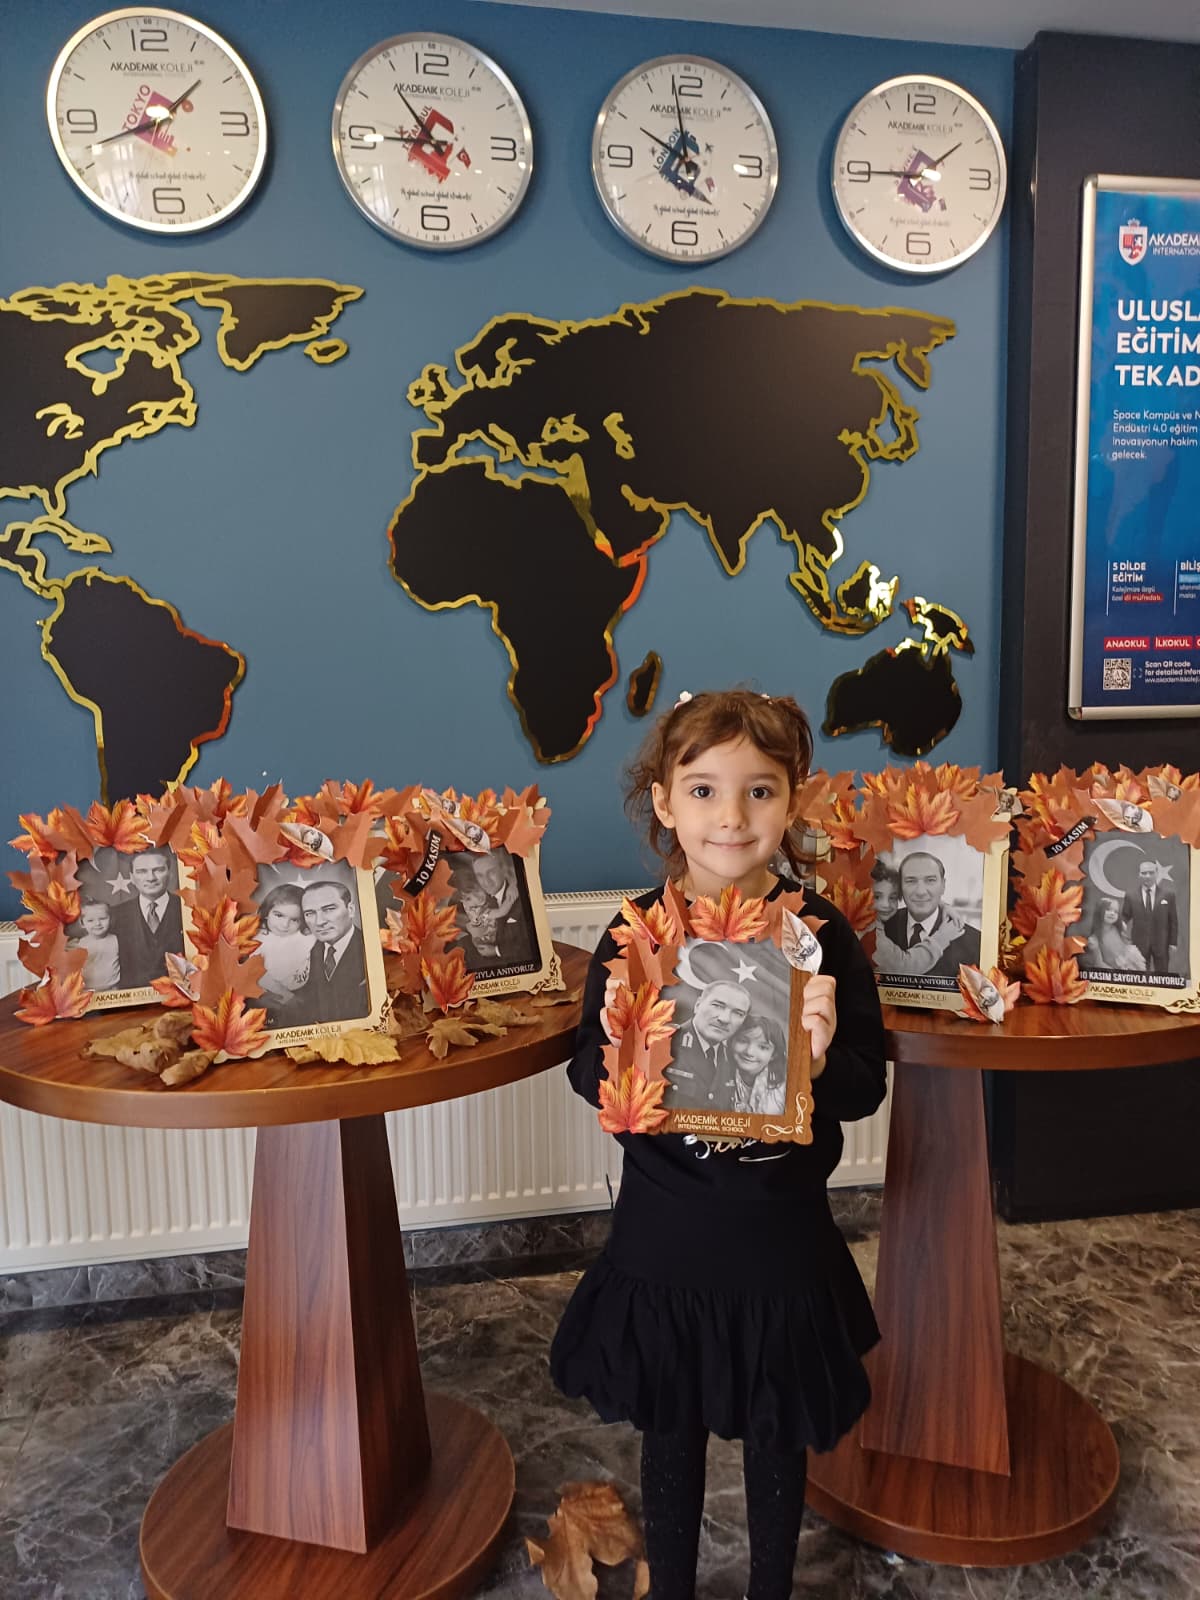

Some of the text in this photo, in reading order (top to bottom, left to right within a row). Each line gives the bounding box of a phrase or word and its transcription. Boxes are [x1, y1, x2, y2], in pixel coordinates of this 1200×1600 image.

[130, 28, 169, 52] 12
[415, 52, 450, 76] 12
[672, 74, 703, 98] 12
[122, 85, 151, 131] TOKYO
[907, 93, 936, 115] 12
[66, 109, 98, 134] 9
[219, 111, 250, 137] 3
[348, 124, 377, 150] 9
[490, 136, 516, 162] 3
[607, 144, 633, 168] 9
[738, 154, 763, 178] 3
[846, 160, 871, 183] 9
[968, 168, 992, 190] 3
[152, 187, 186, 214] 6
[420, 204, 450, 232] 6
[672, 220, 698, 246] 6
[906, 232, 932, 256] 6
[1149, 232, 1200, 246] AKADEM
[1118, 299, 1200, 322] ULUSL
[1116, 326, 1200, 354] EĞİTİM
[1114, 364, 1164, 387] TEK
[1113, 409, 1141, 421] Space
[1144, 409, 1180, 422] Kampüs
[1182, 412, 1192, 420] ve
[1113, 422, 1198, 435] Endüstri 4.0 eğitim
[1112, 560, 1146, 571] 5 DİLDE
[1112, 572, 1144, 582] EĞİTİM
[1106, 640, 1148, 648] ANAOKUL
[1156, 636, 1190, 648] İLKOKUL
[1145, 660, 1191, 668] Scan QR code
[1051, 821, 1088, 854] 10 KASIM
[416, 834, 440, 886] 10 KASIM
[496, 964, 534, 976] ANIYORUZ
[886, 975, 956, 986] SAYGIYLA ANIYORUZ
[1080, 971, 1186, 986] 10 KASIM SAYGIYLA ANIYORUZ
[678, 1123, 745, 1134] INTERNATIONAL SCHOOL
